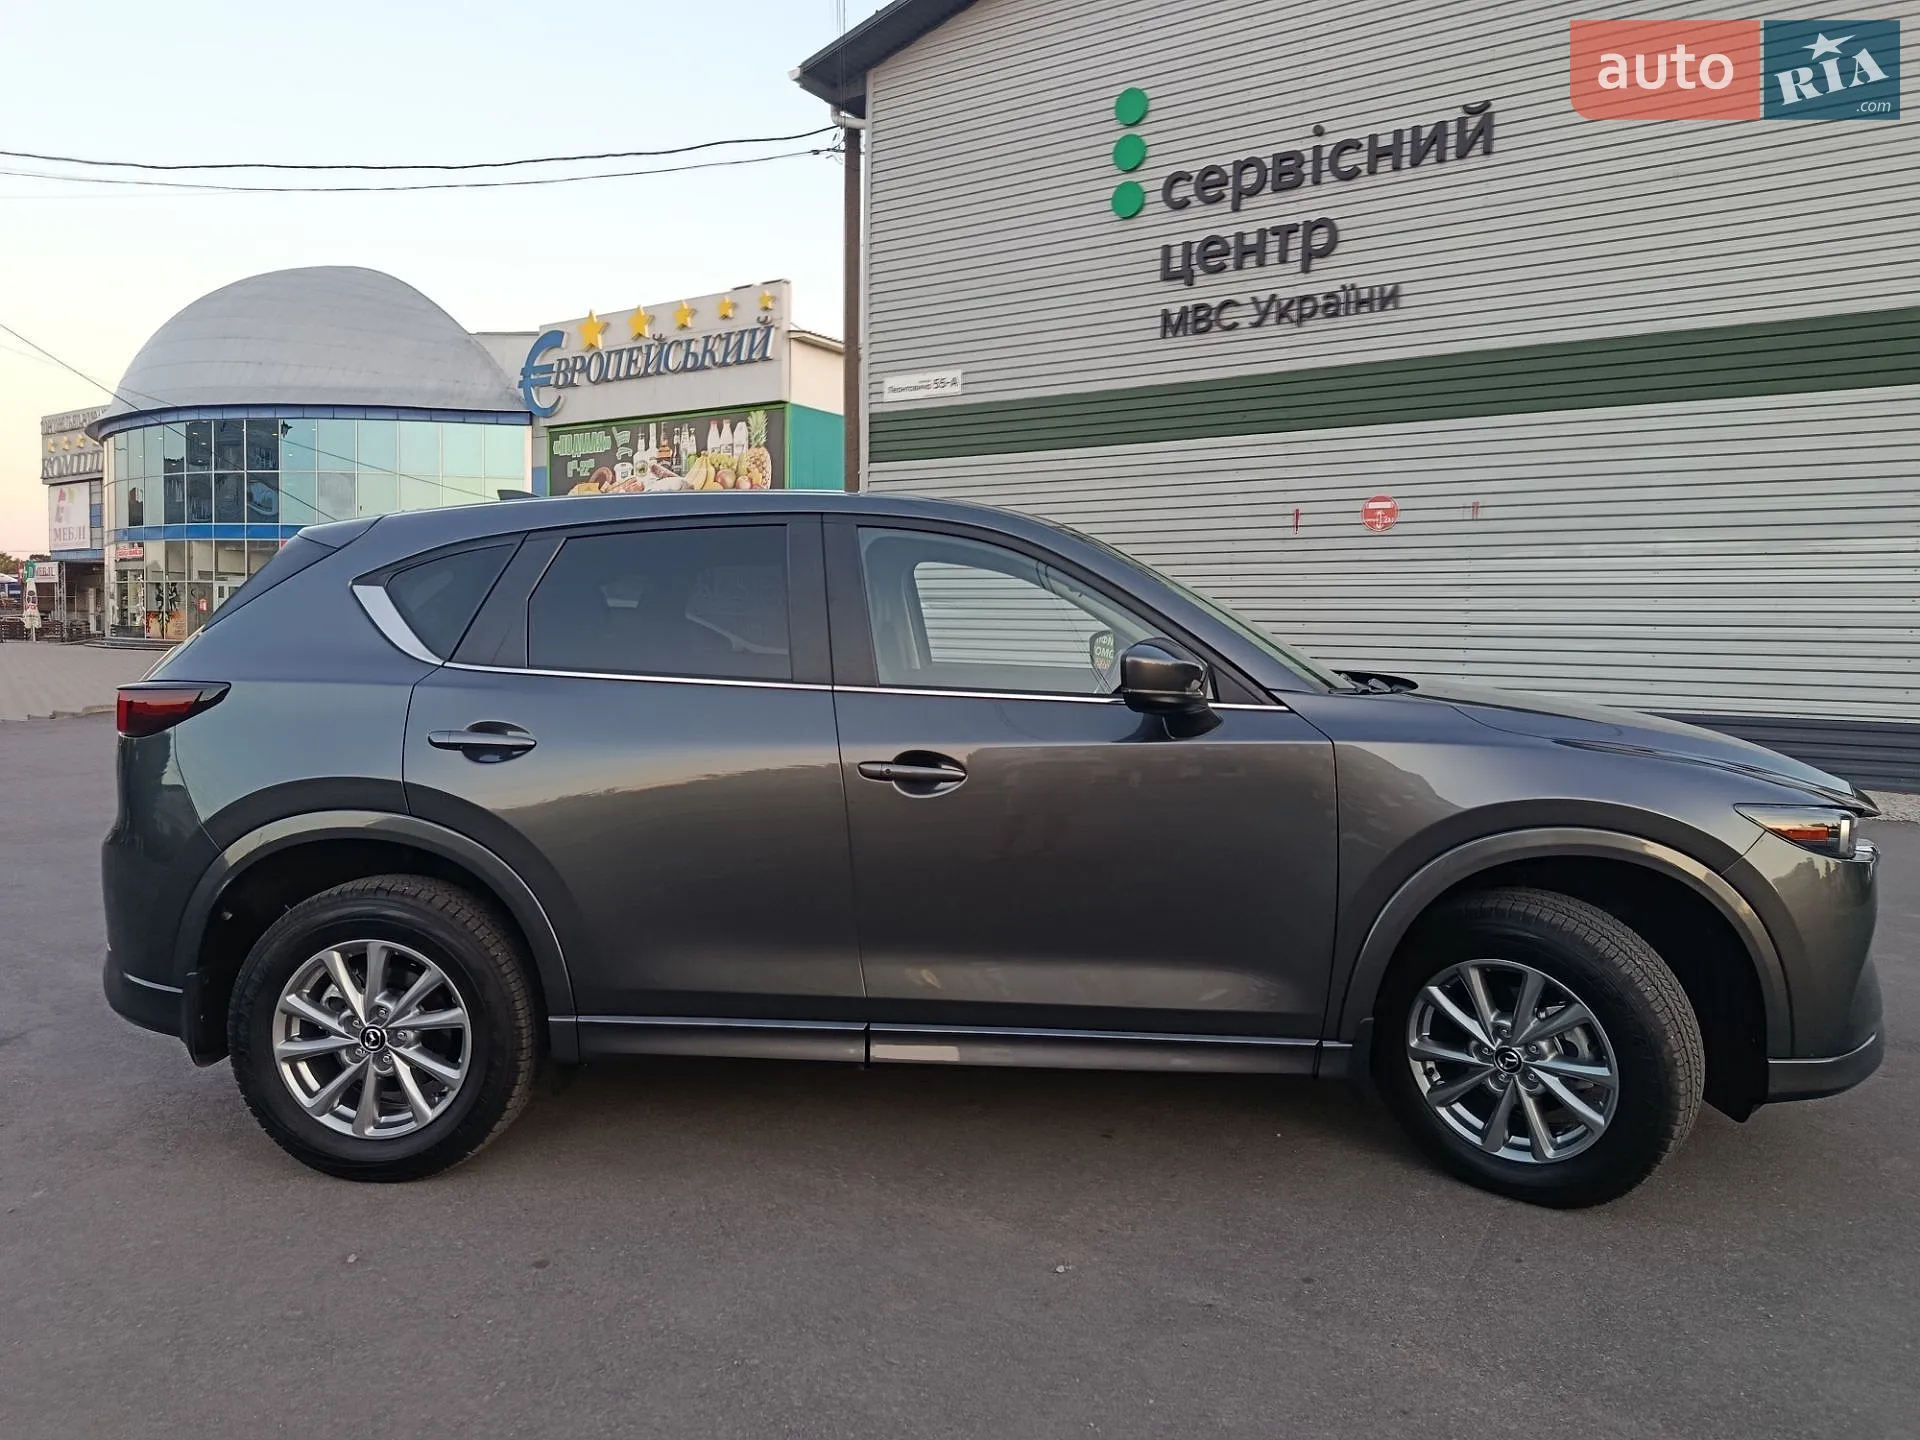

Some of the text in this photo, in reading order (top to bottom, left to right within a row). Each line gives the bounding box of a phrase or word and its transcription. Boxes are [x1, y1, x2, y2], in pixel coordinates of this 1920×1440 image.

[1161, 100, 1495, 212] сервісний
[1160, 217, 1338, 286] центр
[1160, 282, 1402, 338] МВС України
